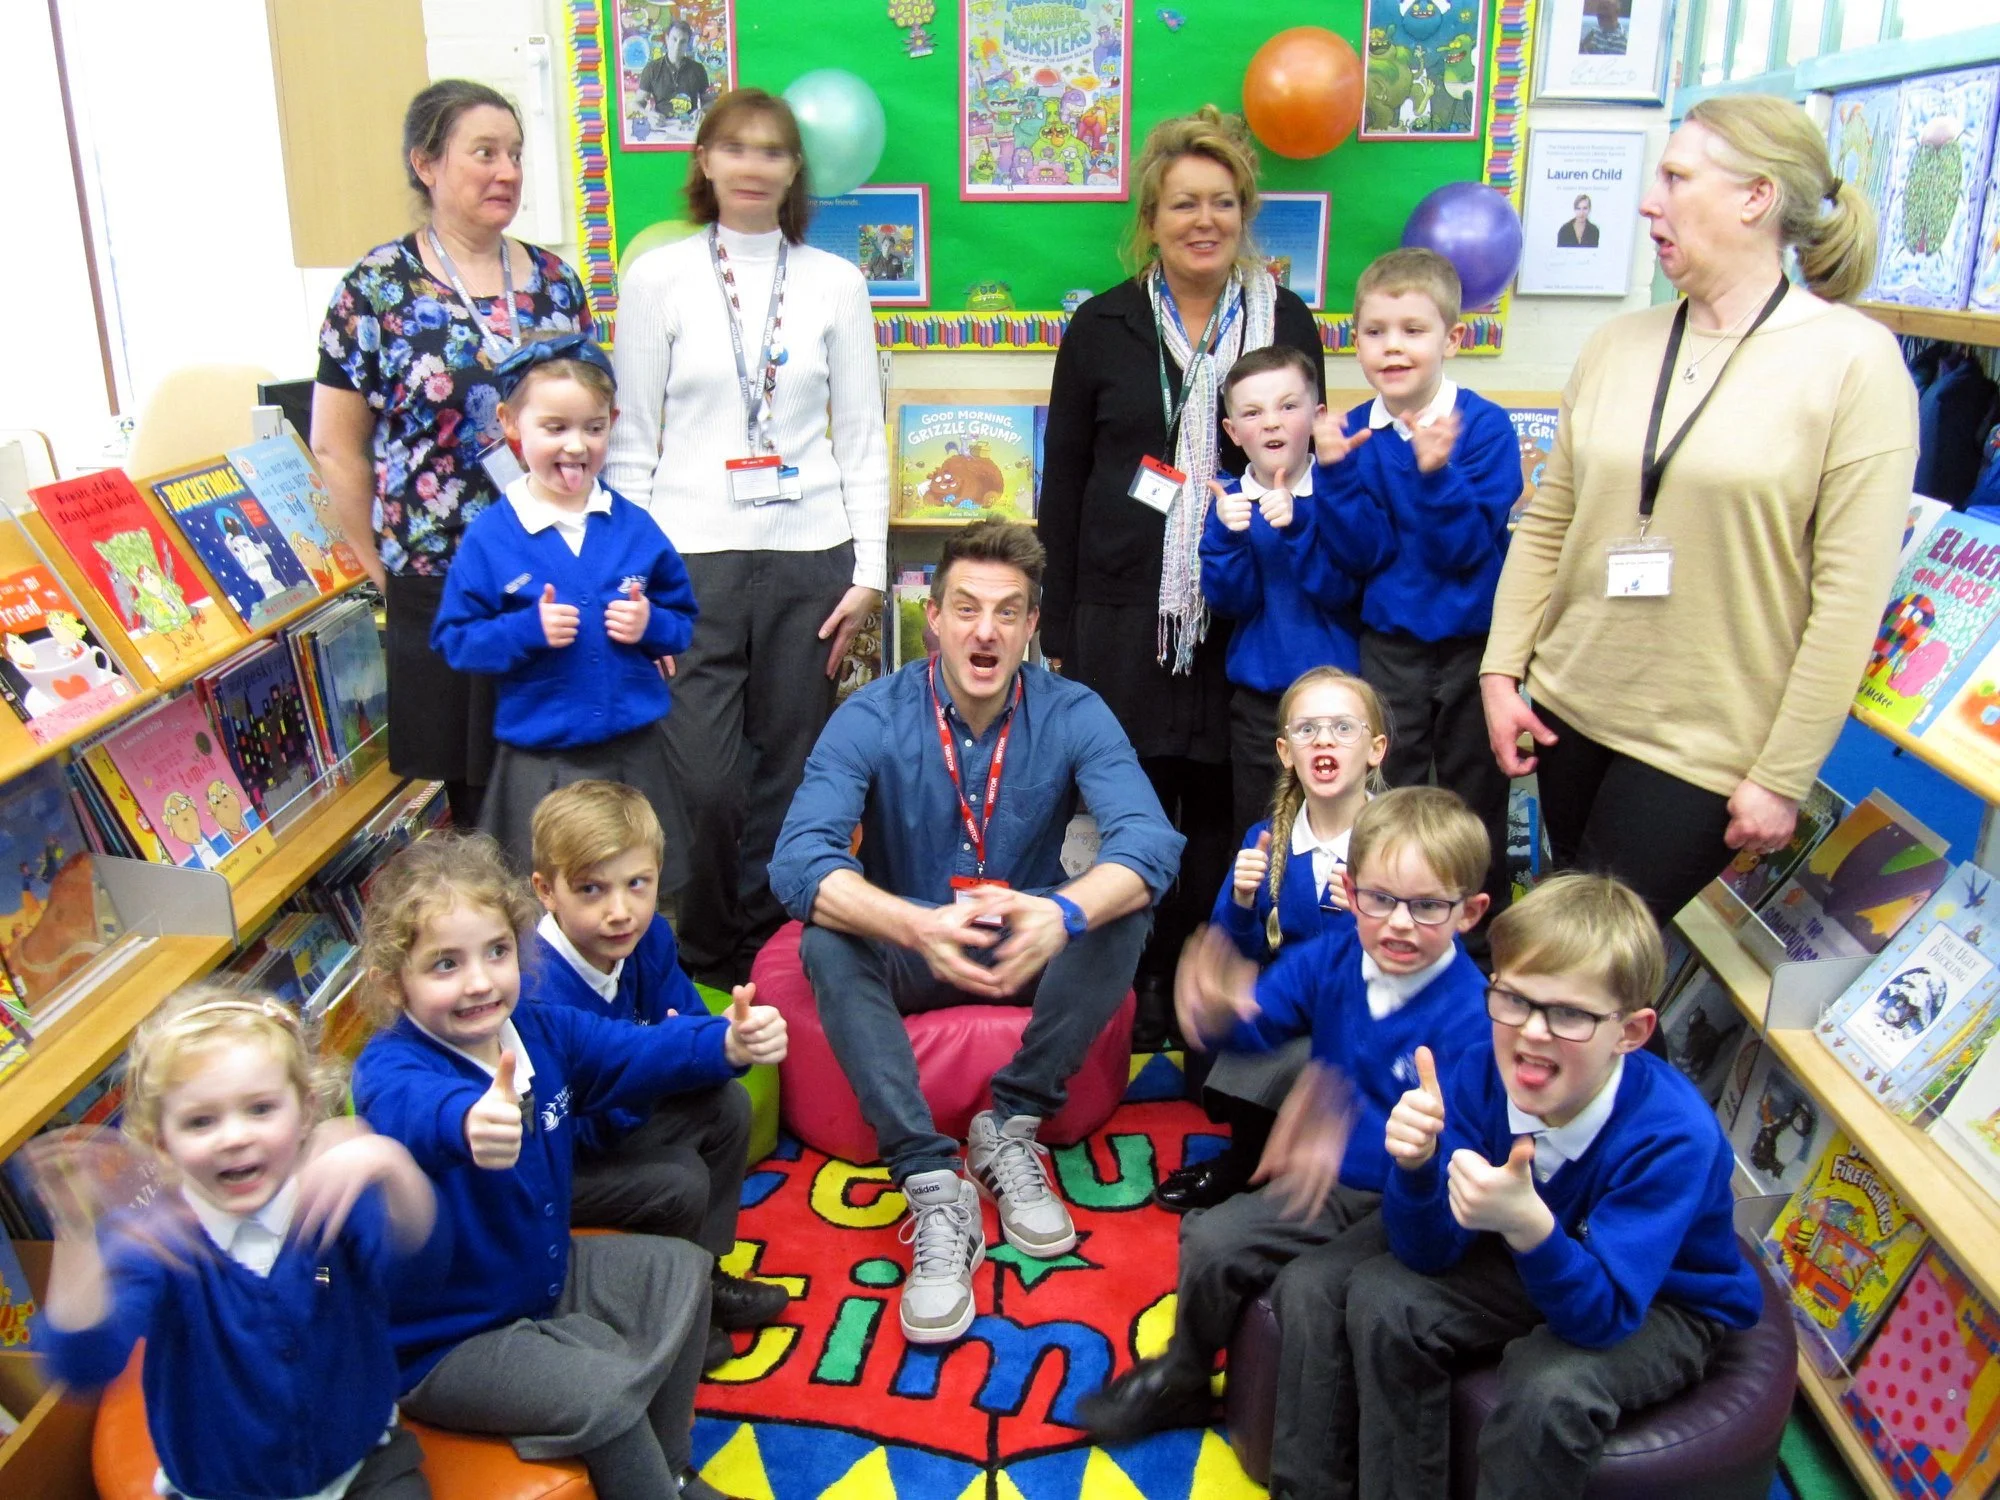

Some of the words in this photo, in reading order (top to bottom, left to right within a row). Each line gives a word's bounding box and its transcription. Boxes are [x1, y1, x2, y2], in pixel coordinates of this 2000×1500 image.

[1004, 20, 1092, 57] MONSTERS
[1547, 168, 1588, 180] Lauren
[1592, 168, 1622, 180] Child
[774, 265, 784, 295] VISITOR
[764, 316, 775, 347] VISITOR
[1203, 314, 1217, 343] VOLUNTEER
[1219, 317, 1231, 335] STAFF
[755, 368, 766, 400] VISITOR
[1186, 352, 1202, 387] VOLUNTEER
[921, 412, 954, 425] GOOD
[958, 410, 1014, 429] MORNING,
[1164, 388, 1173, 426] VOLUNTEER
[1509, 412, 1558, 426] ODNIGHT,
[908, 421, 965, 445] GRIZZLE
[968, 421, 1022, 445] GRUMP!
[101, 474, 118, 493] the
[163, 466, 244, 511] ROCKETMOLE
[1912, 566, 1953, 589] and
[1945, 574, 1995, 608] ROSE
[944, 743, 955, 772] VISITOR
[995, 737, 1006, 764] VISITOR
[987, 777, 998, 804] VISITOR
[966, 818, 980, 844] VISITOR
[1927, 946, 1968, 983] DUCKLING
[911, 1183, 941, 1195] adidas
[1831, 1154, 1893, 1237] FIREFIGHTERS
